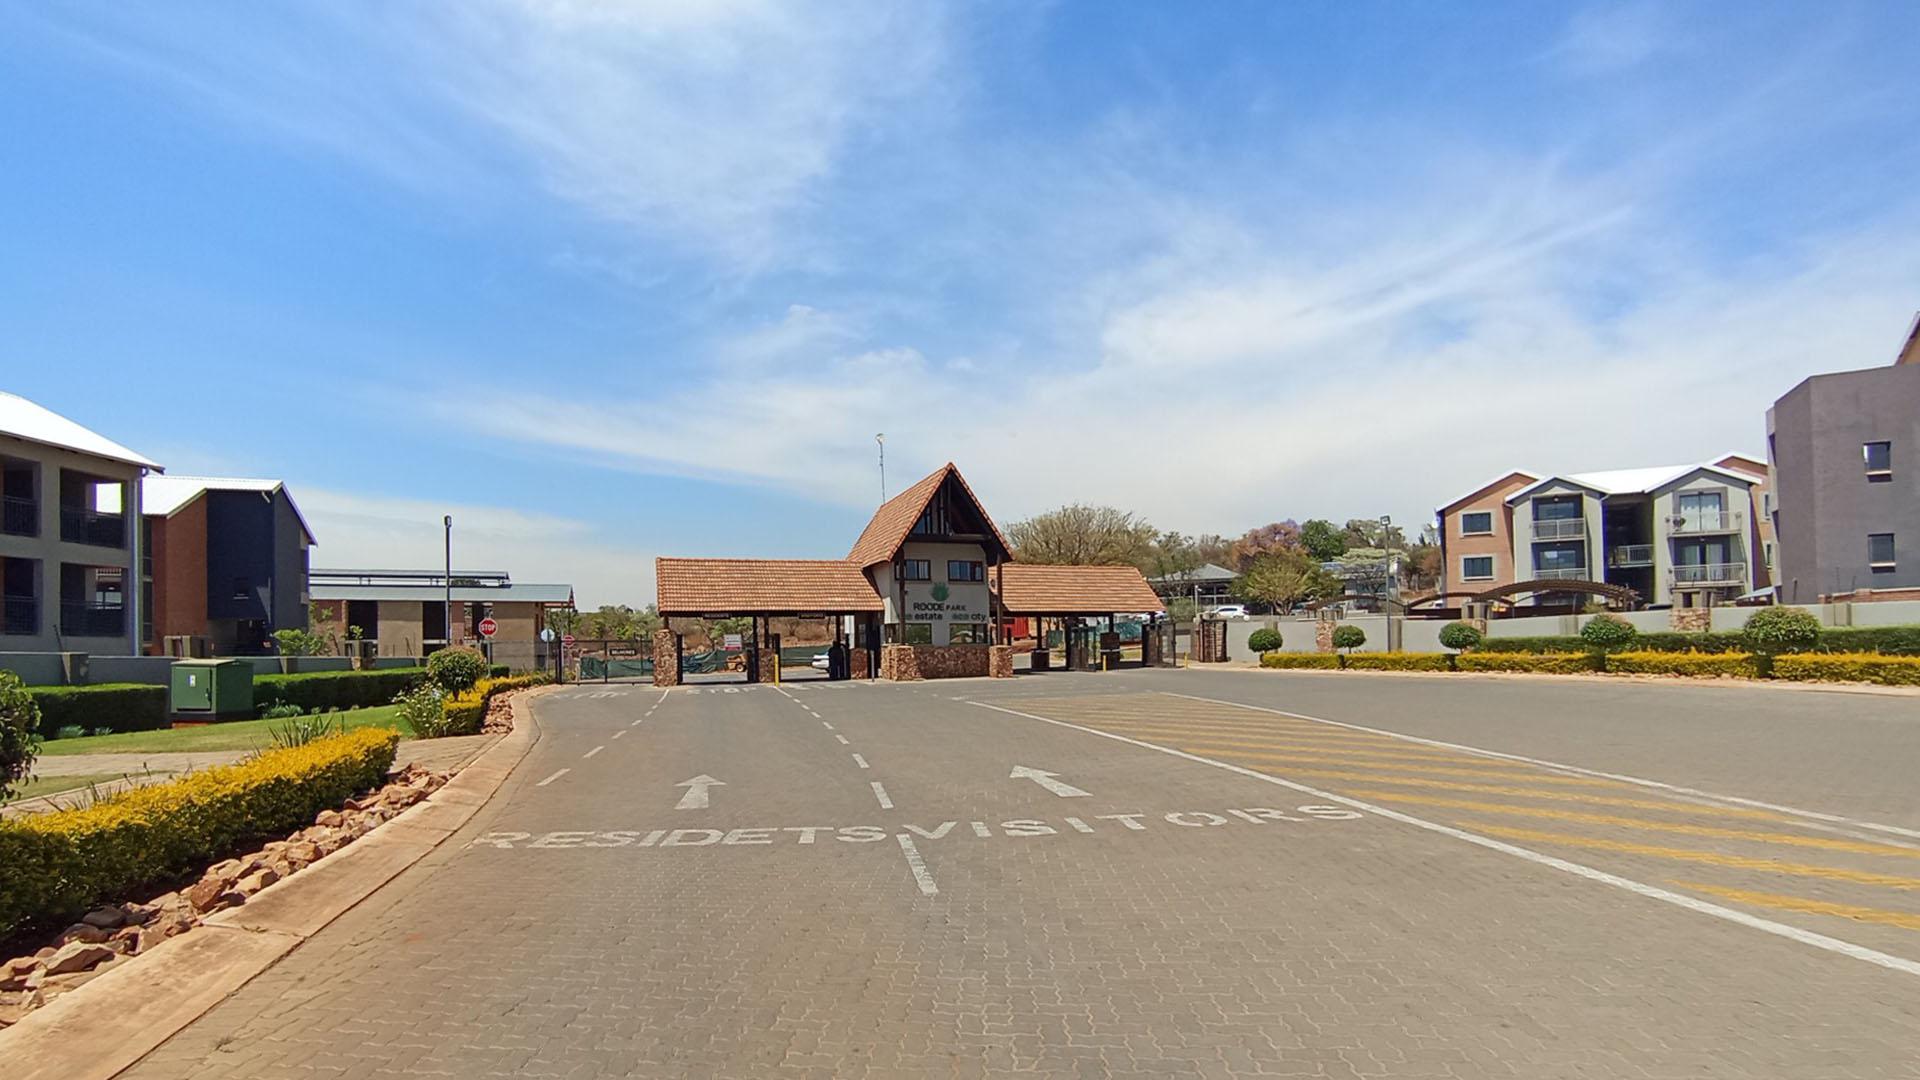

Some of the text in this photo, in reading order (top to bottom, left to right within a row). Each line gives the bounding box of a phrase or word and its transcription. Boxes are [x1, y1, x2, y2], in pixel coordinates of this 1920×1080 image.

[913, 602, 944, 611] ROODE
[971, 613, 986, 622] city
[481, 623, 496, 631] STOP
[902, 804, 1363, 840] VISITORS
[467, 825, 888, 848] RESIDETS
